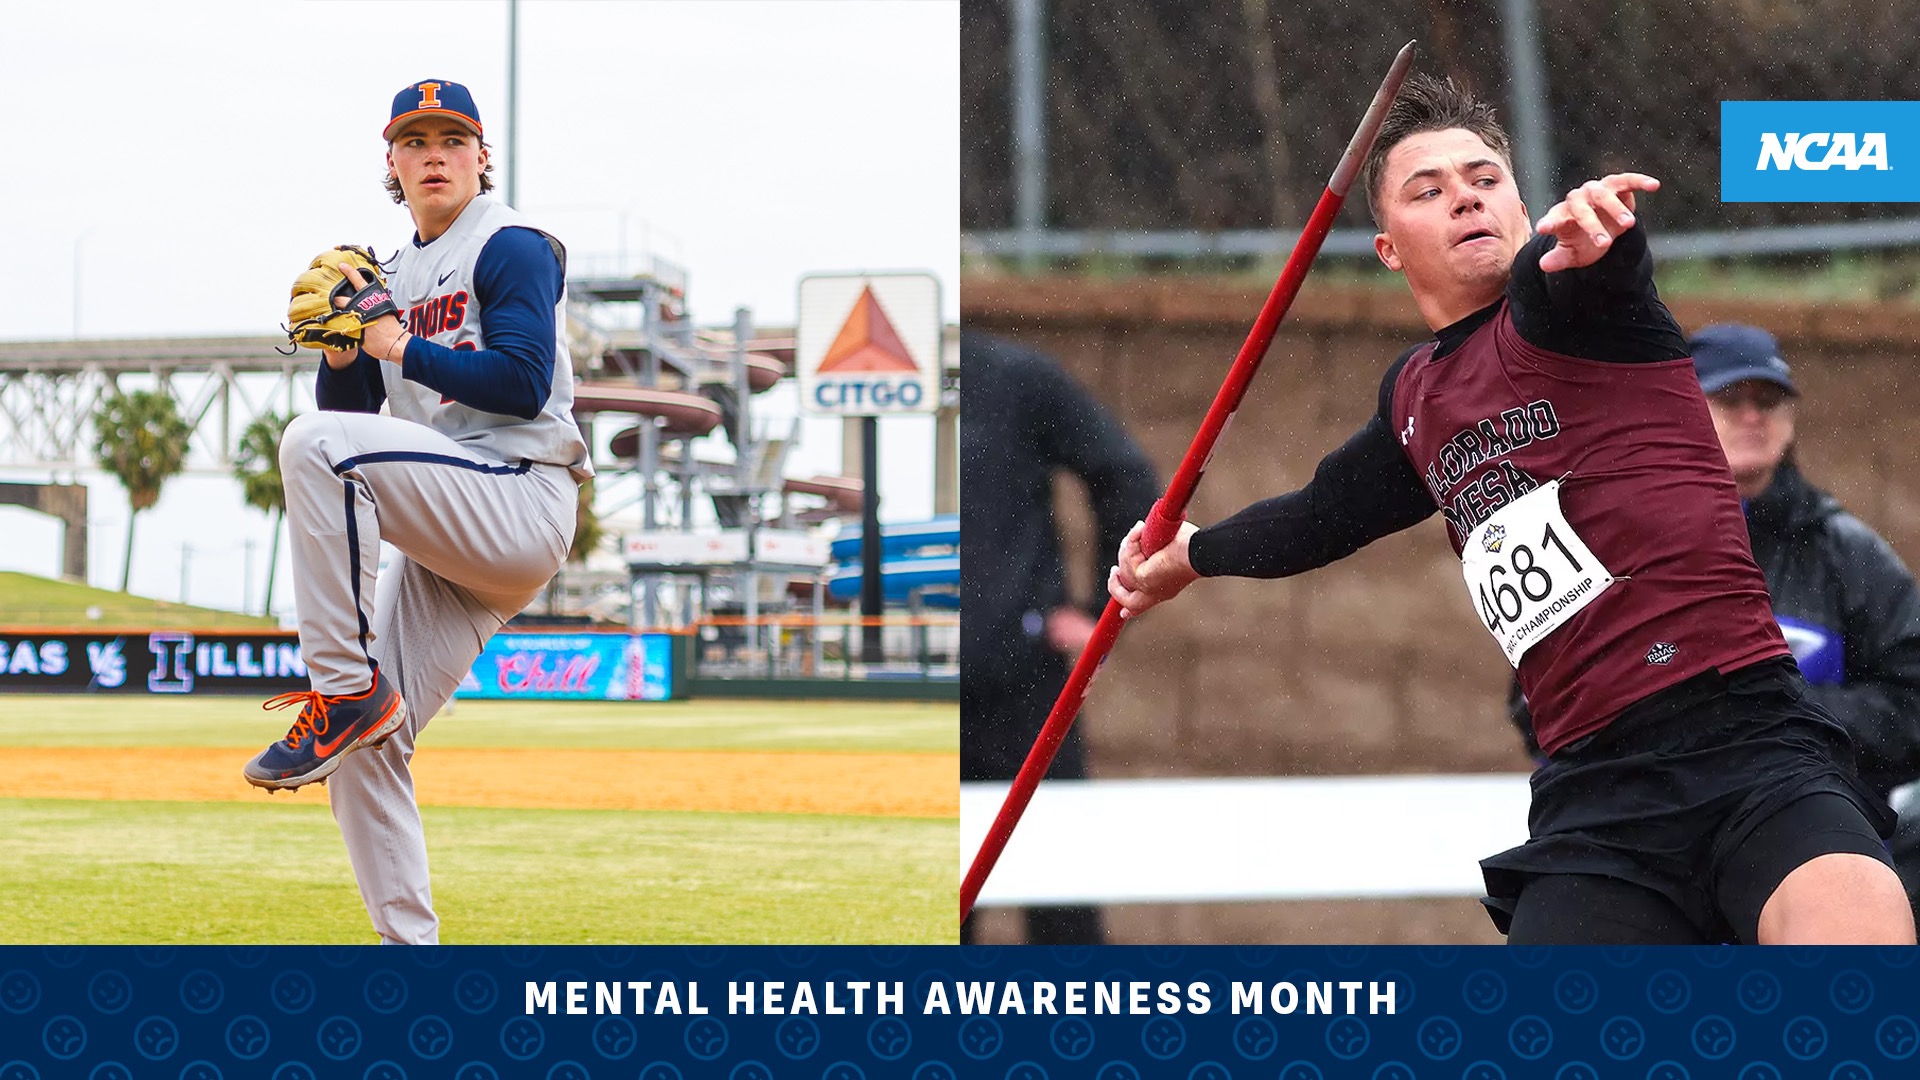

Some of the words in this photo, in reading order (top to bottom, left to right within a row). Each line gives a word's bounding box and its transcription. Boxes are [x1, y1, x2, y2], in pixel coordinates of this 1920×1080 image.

[418, 82, 441, 109] I
[398, 290, 469, 340] INOIS
[815, 381, 922, 407] CITGO
[1443, 459, 1539, 547] MESA
[1480, 522, 1583, 636] 4681
[1515, 577, 1593, 641] CHAMPIONSHIP
[495, 650, 601, 693] Chill
